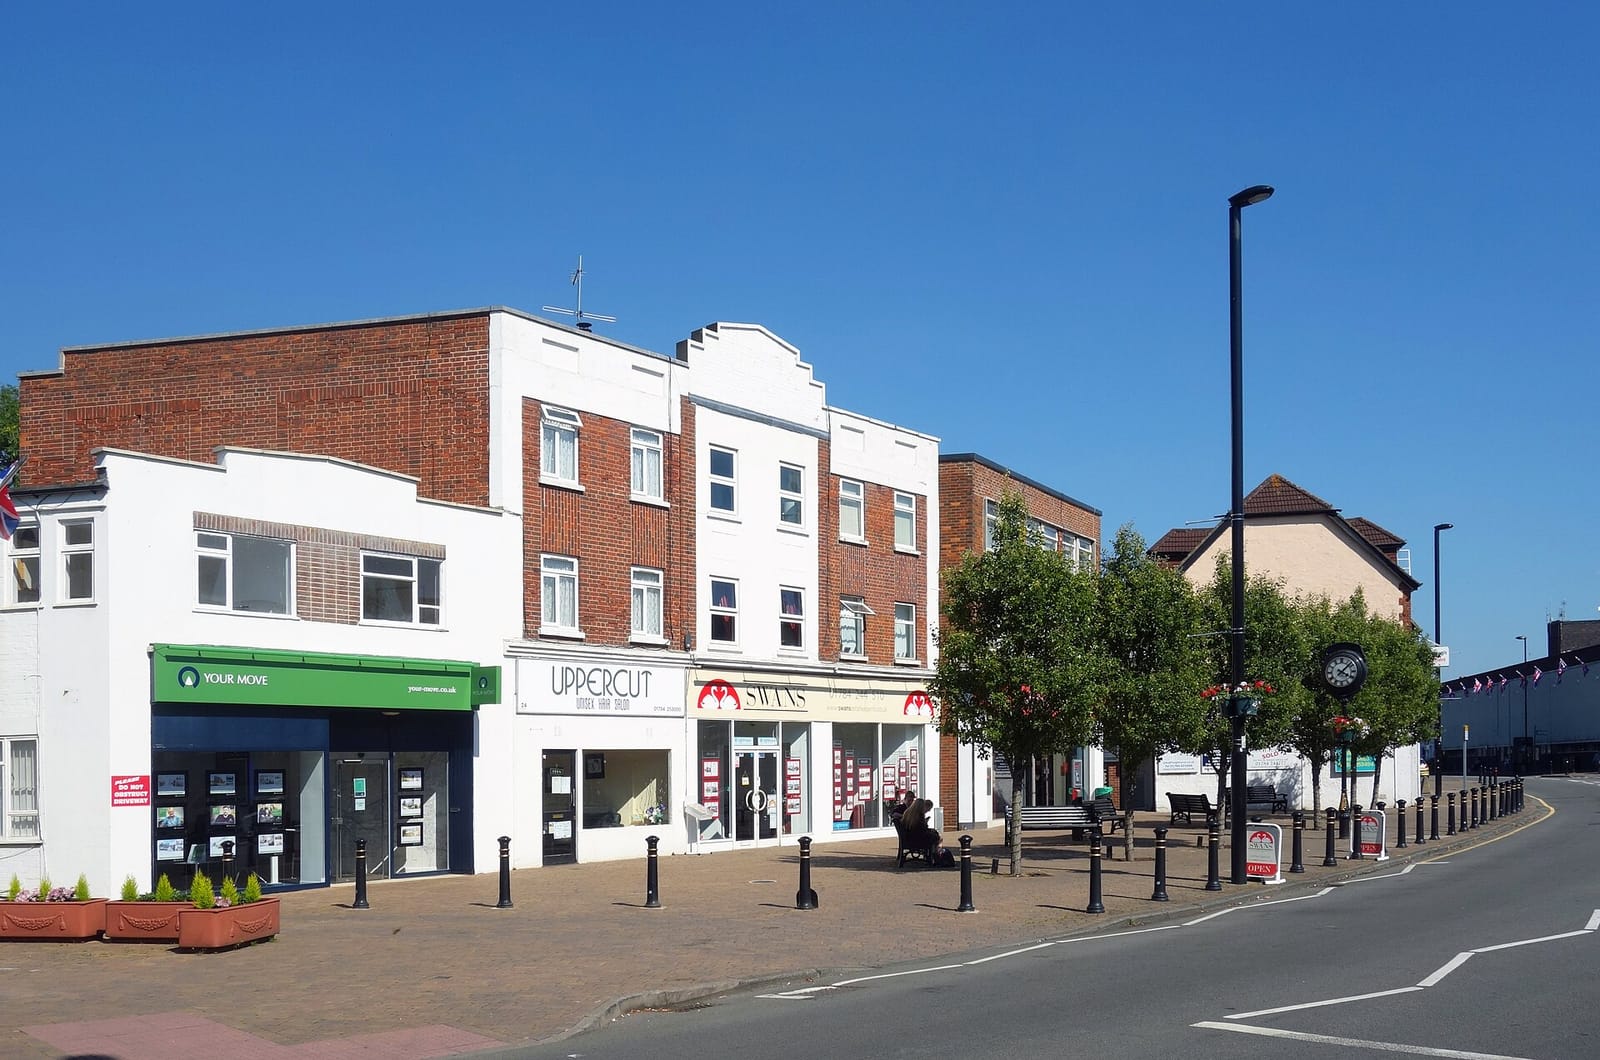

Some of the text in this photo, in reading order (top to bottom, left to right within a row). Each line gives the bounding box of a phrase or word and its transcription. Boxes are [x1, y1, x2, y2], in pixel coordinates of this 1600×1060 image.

[204, 672, 268, 685] YOUR MOVE
[552, 665, 652, 698] UPPERCUT
[746, 686, 806, 708] SWANS
[576, 697, 630, 711] UNISEX HAIR SALON
[1262, 751, 1279, 759] SOLD
[1247, 864, 1272, 873] OPEN
